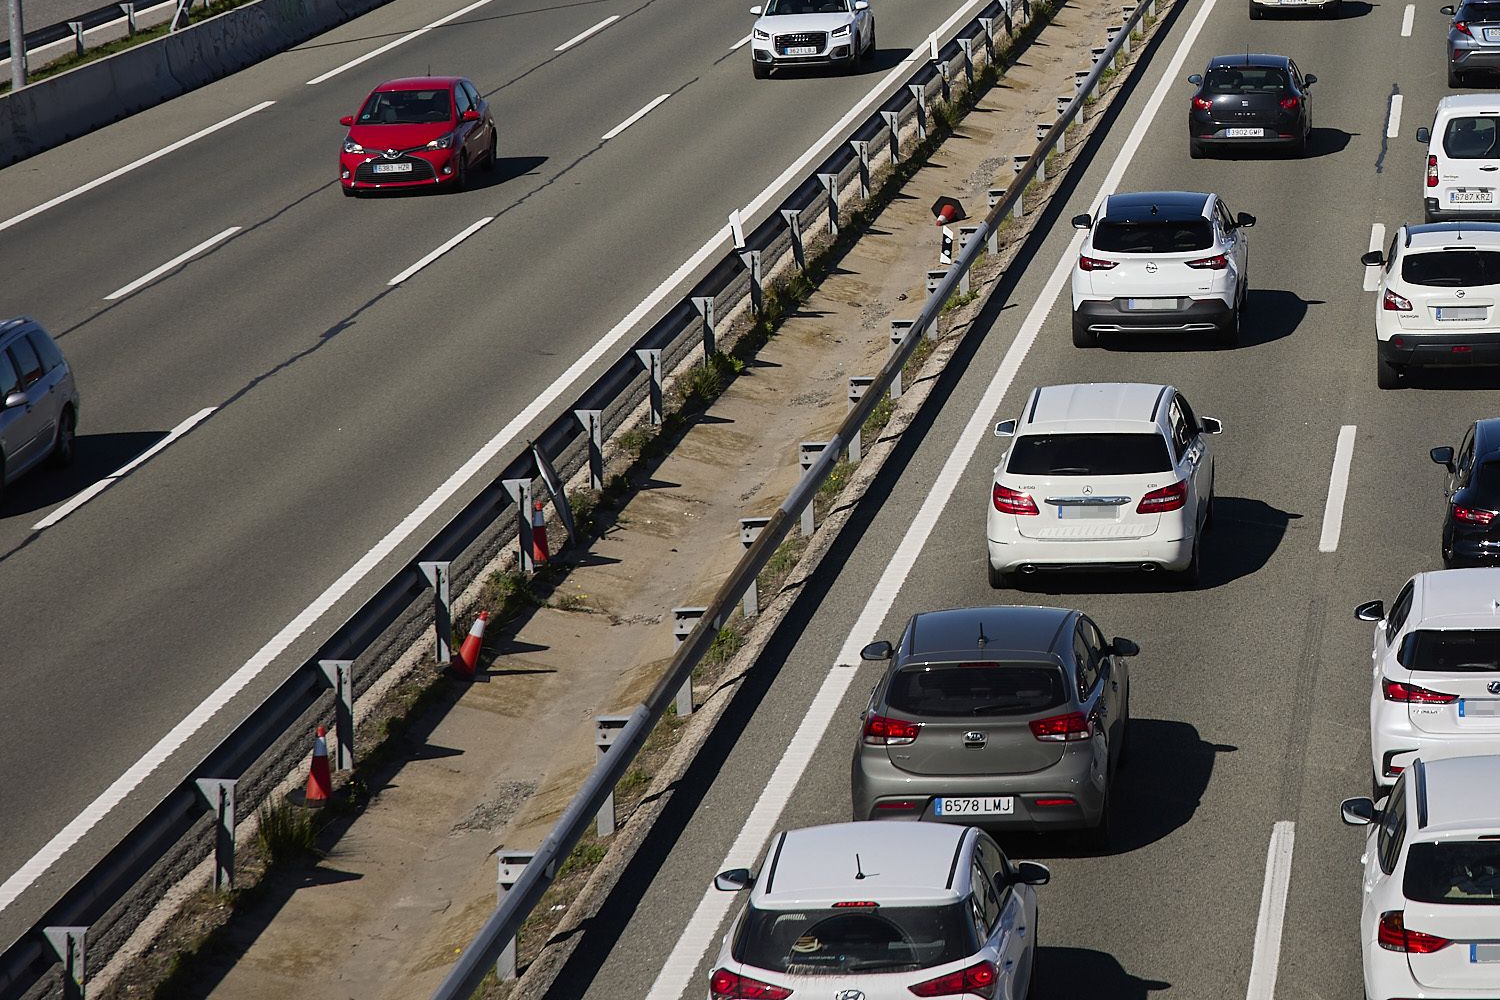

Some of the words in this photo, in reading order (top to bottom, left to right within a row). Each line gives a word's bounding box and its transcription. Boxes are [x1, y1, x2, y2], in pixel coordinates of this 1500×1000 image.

[1455, 193, 1474, 201] 6787
[1474, 193, 1490, 201] KRZ
[945, 799, 980, 812] 6578
[983, 798, 1011, 812] LMJ
